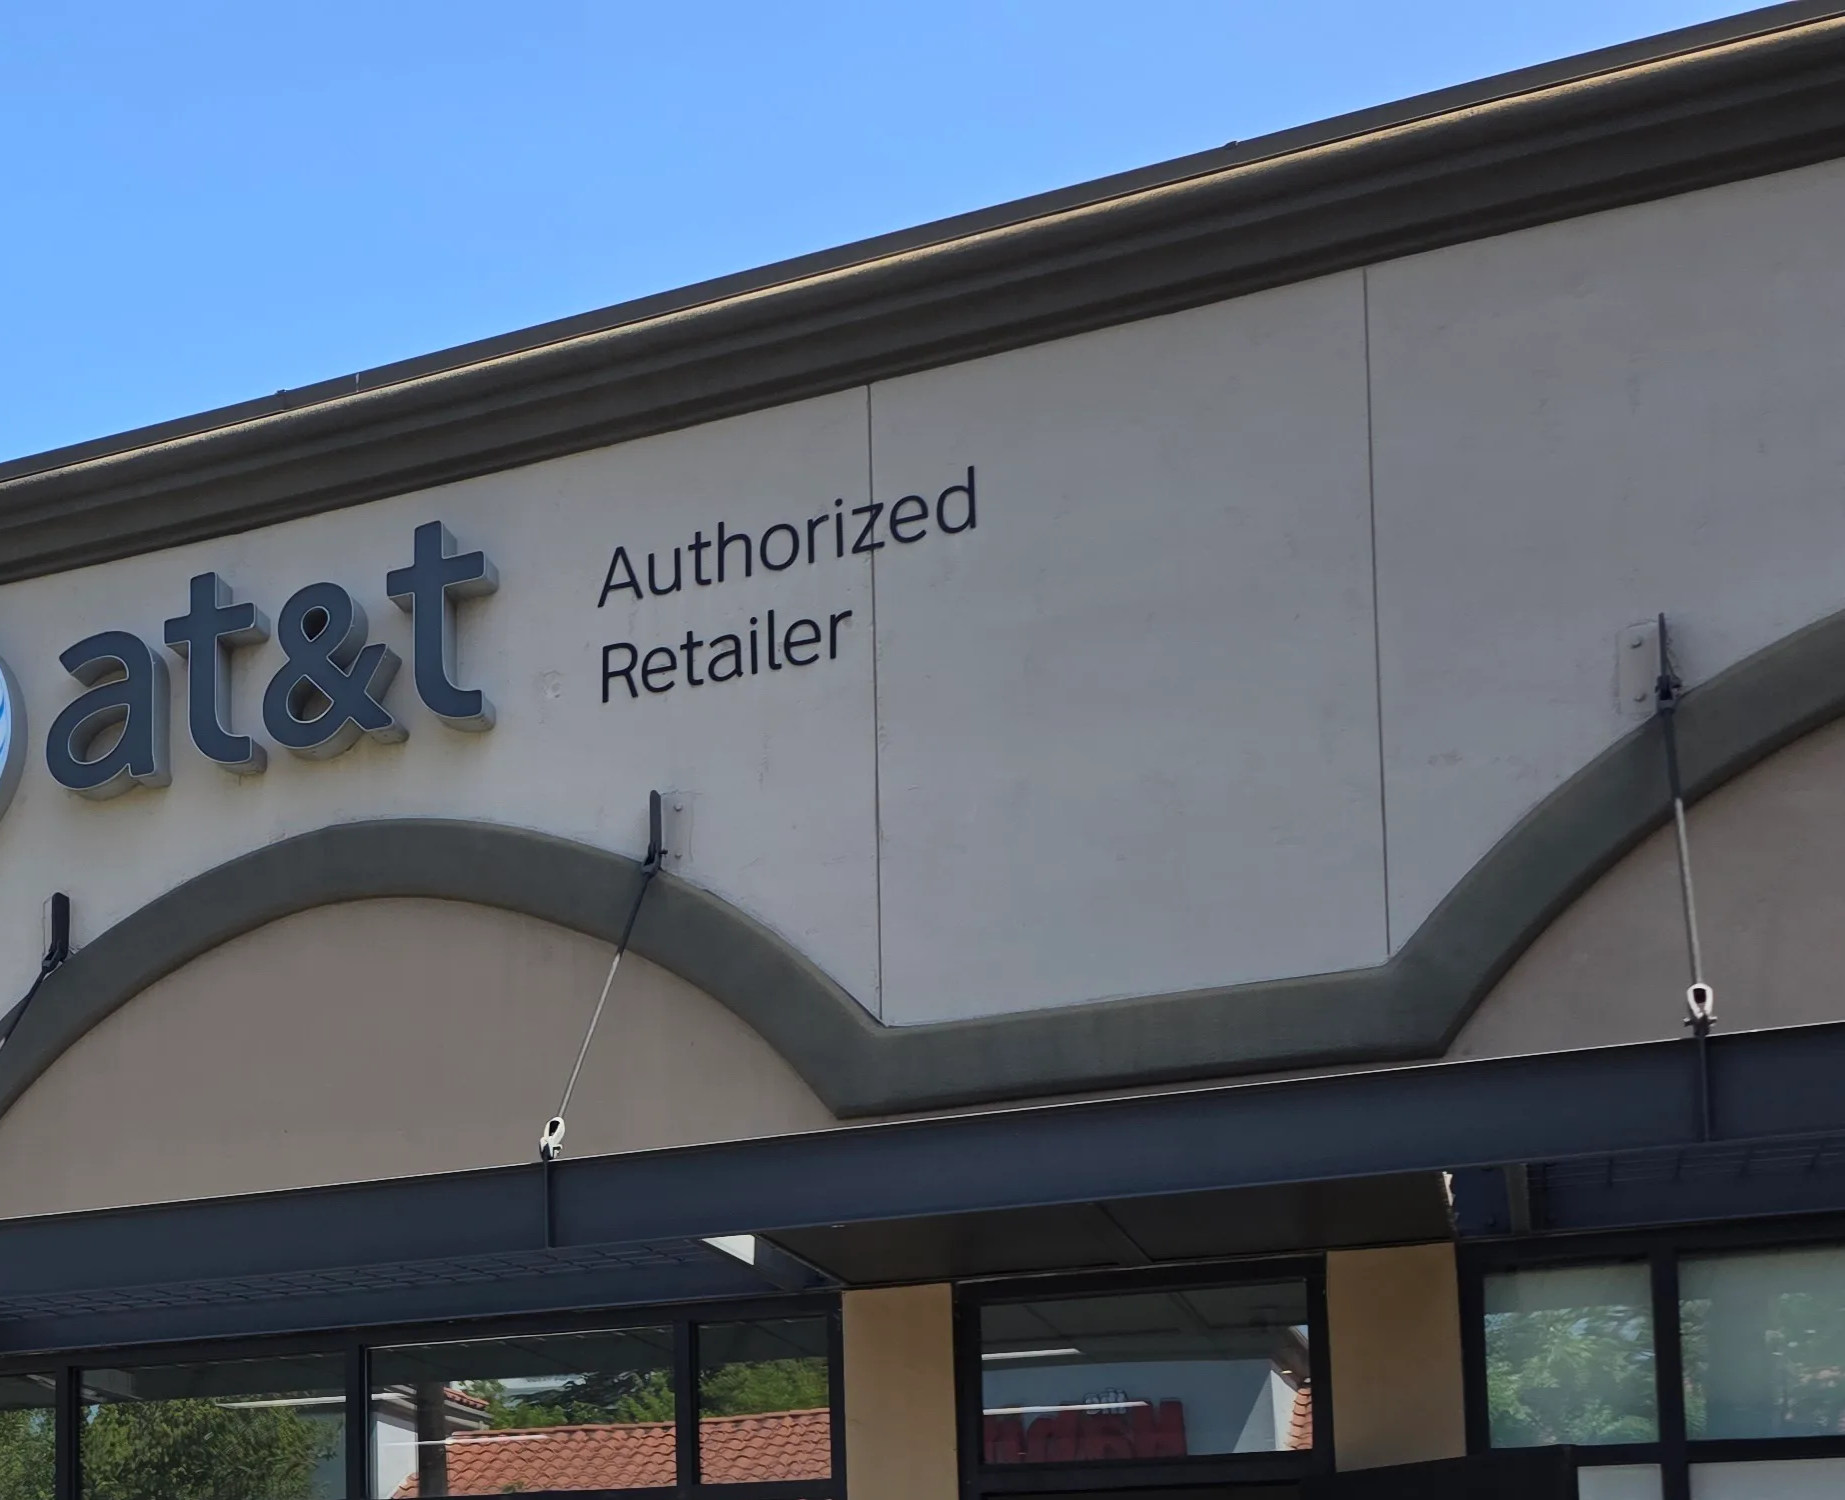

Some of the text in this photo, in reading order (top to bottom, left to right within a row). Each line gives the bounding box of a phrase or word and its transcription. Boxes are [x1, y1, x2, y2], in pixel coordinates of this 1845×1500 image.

[597, 465, 977, 608] Authorized
[46, 520, 499, 800] at&t
[601, 609, 853, 703] Retailer
